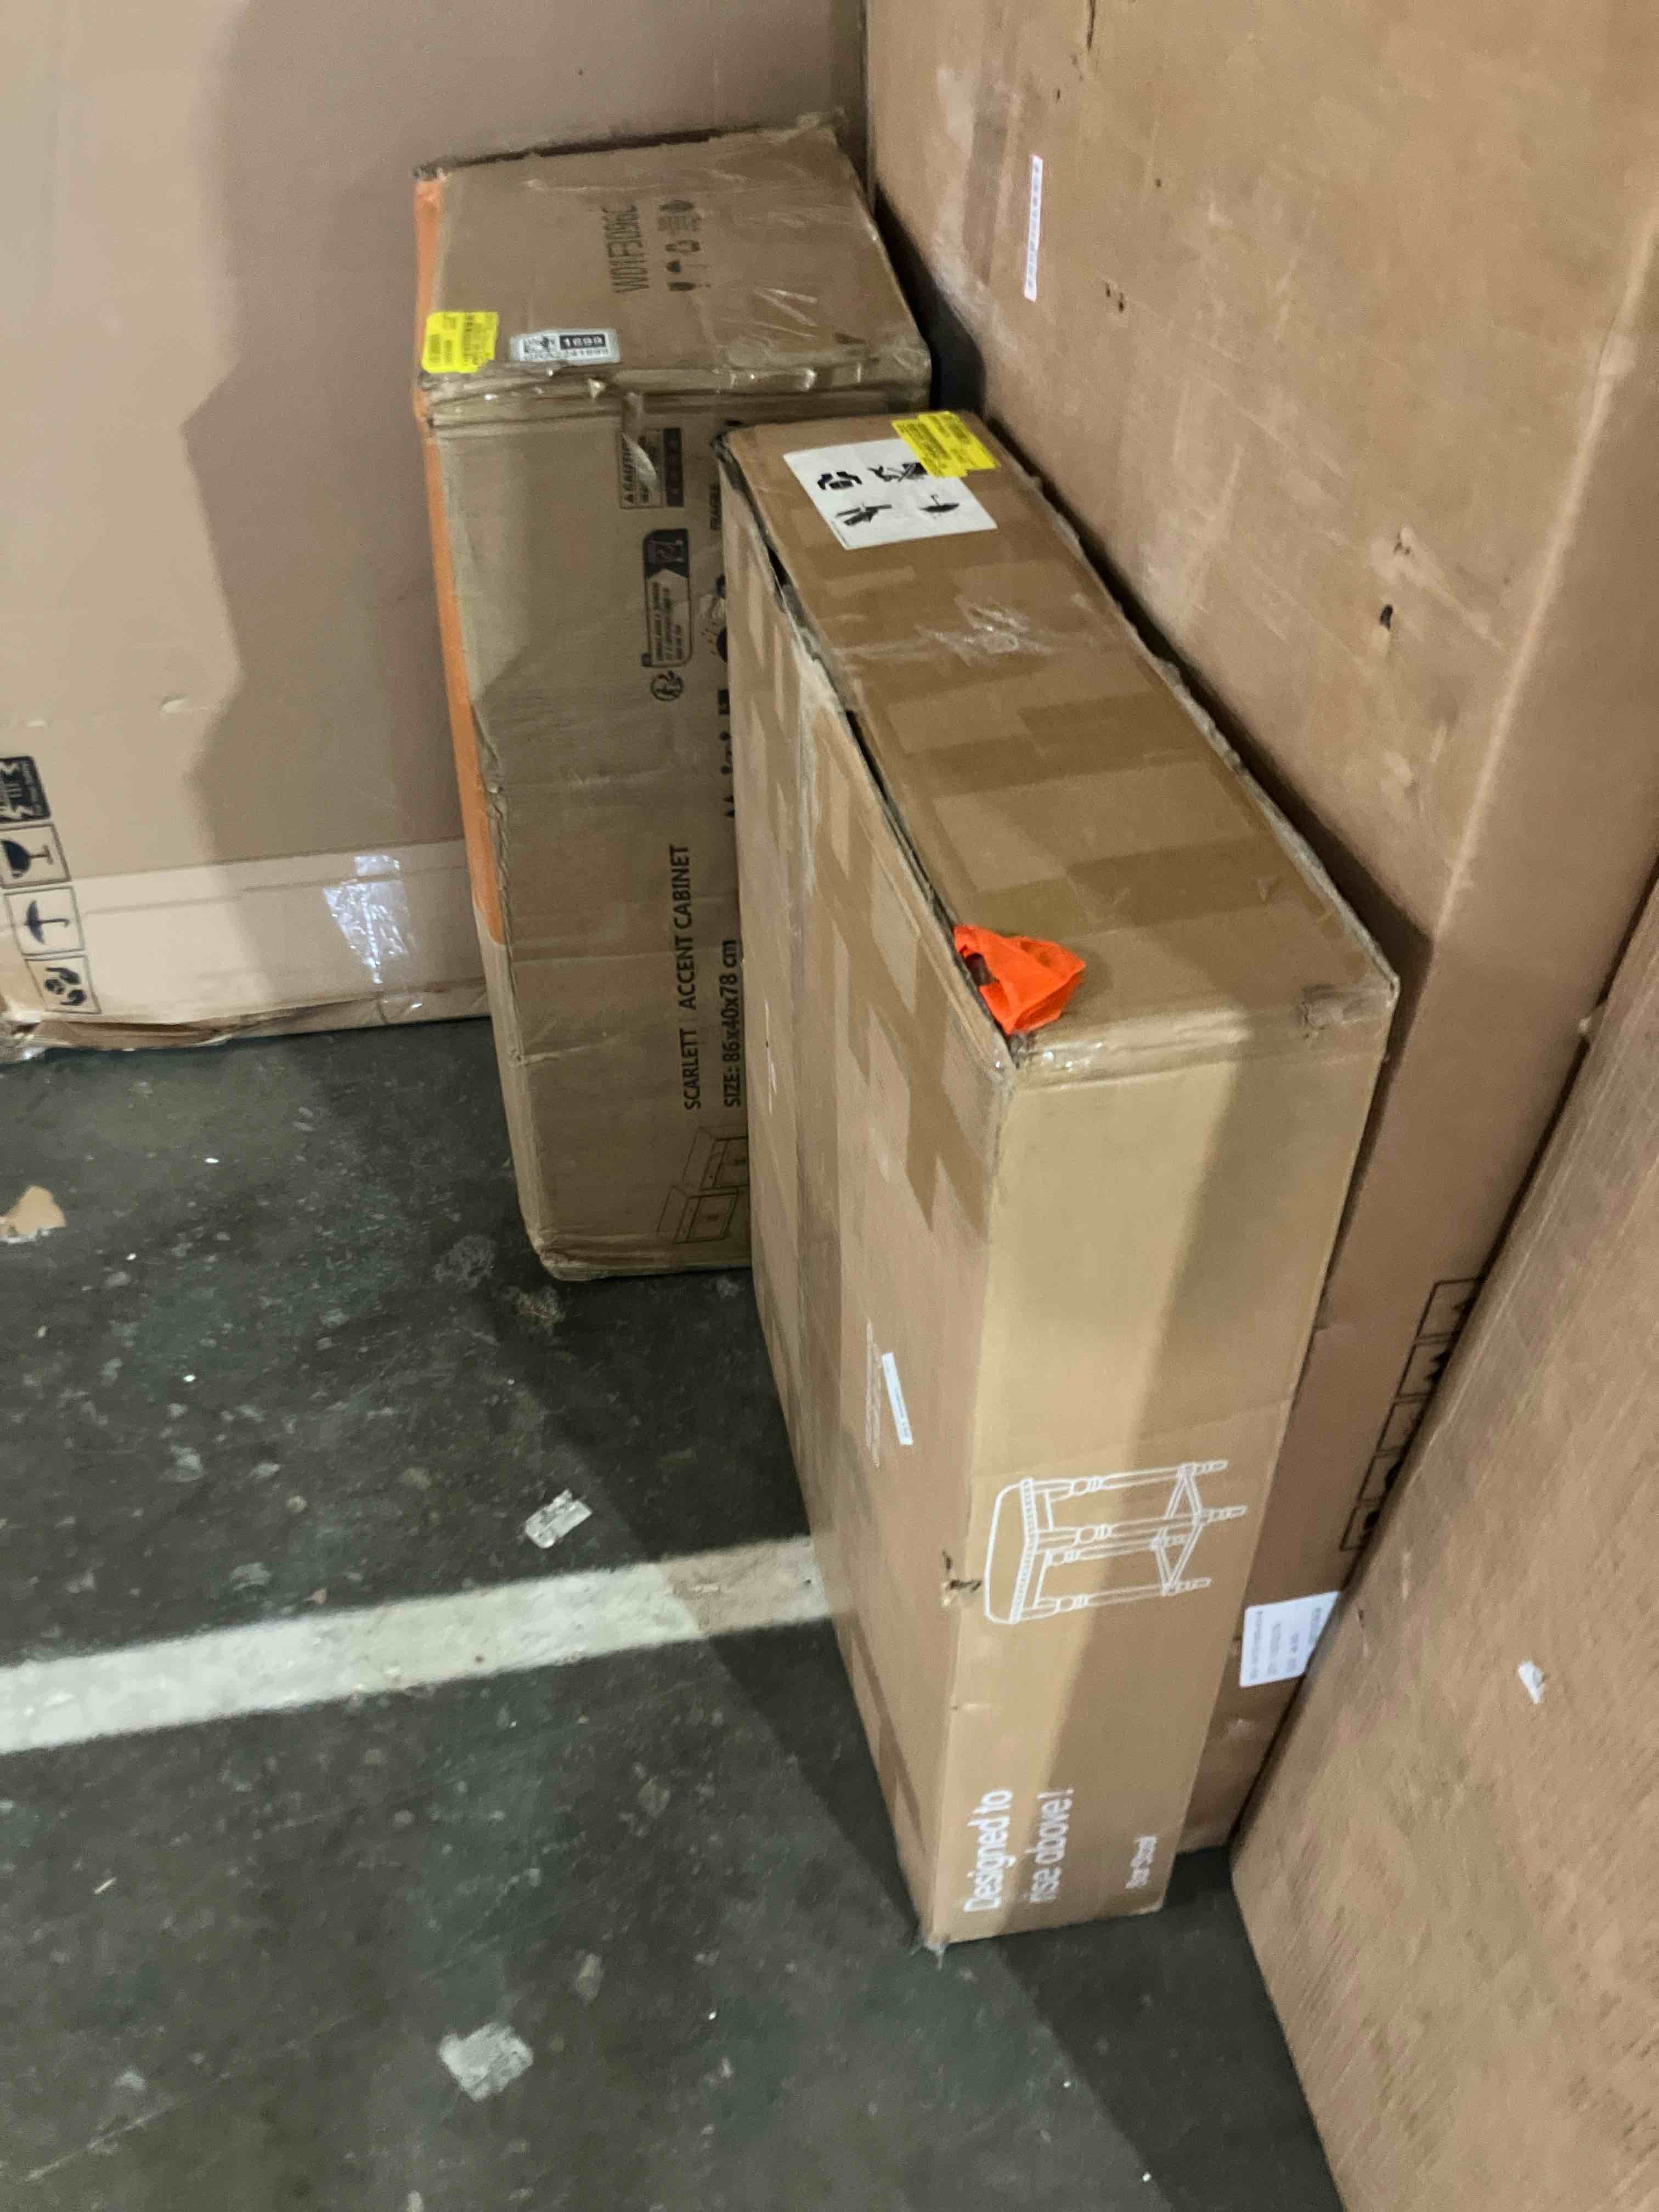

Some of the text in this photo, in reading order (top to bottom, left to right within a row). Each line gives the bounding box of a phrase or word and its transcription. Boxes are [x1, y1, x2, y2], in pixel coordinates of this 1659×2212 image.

[670, 845, 701, 1111] SCARLETT ACCENT CABINET
[720, 939, 741, 1108] SIZE: 86x40x78 cm
[964, 1790, 1017, 1912] Designed to
[1022, 1788, 1075, 1903] rise above!
